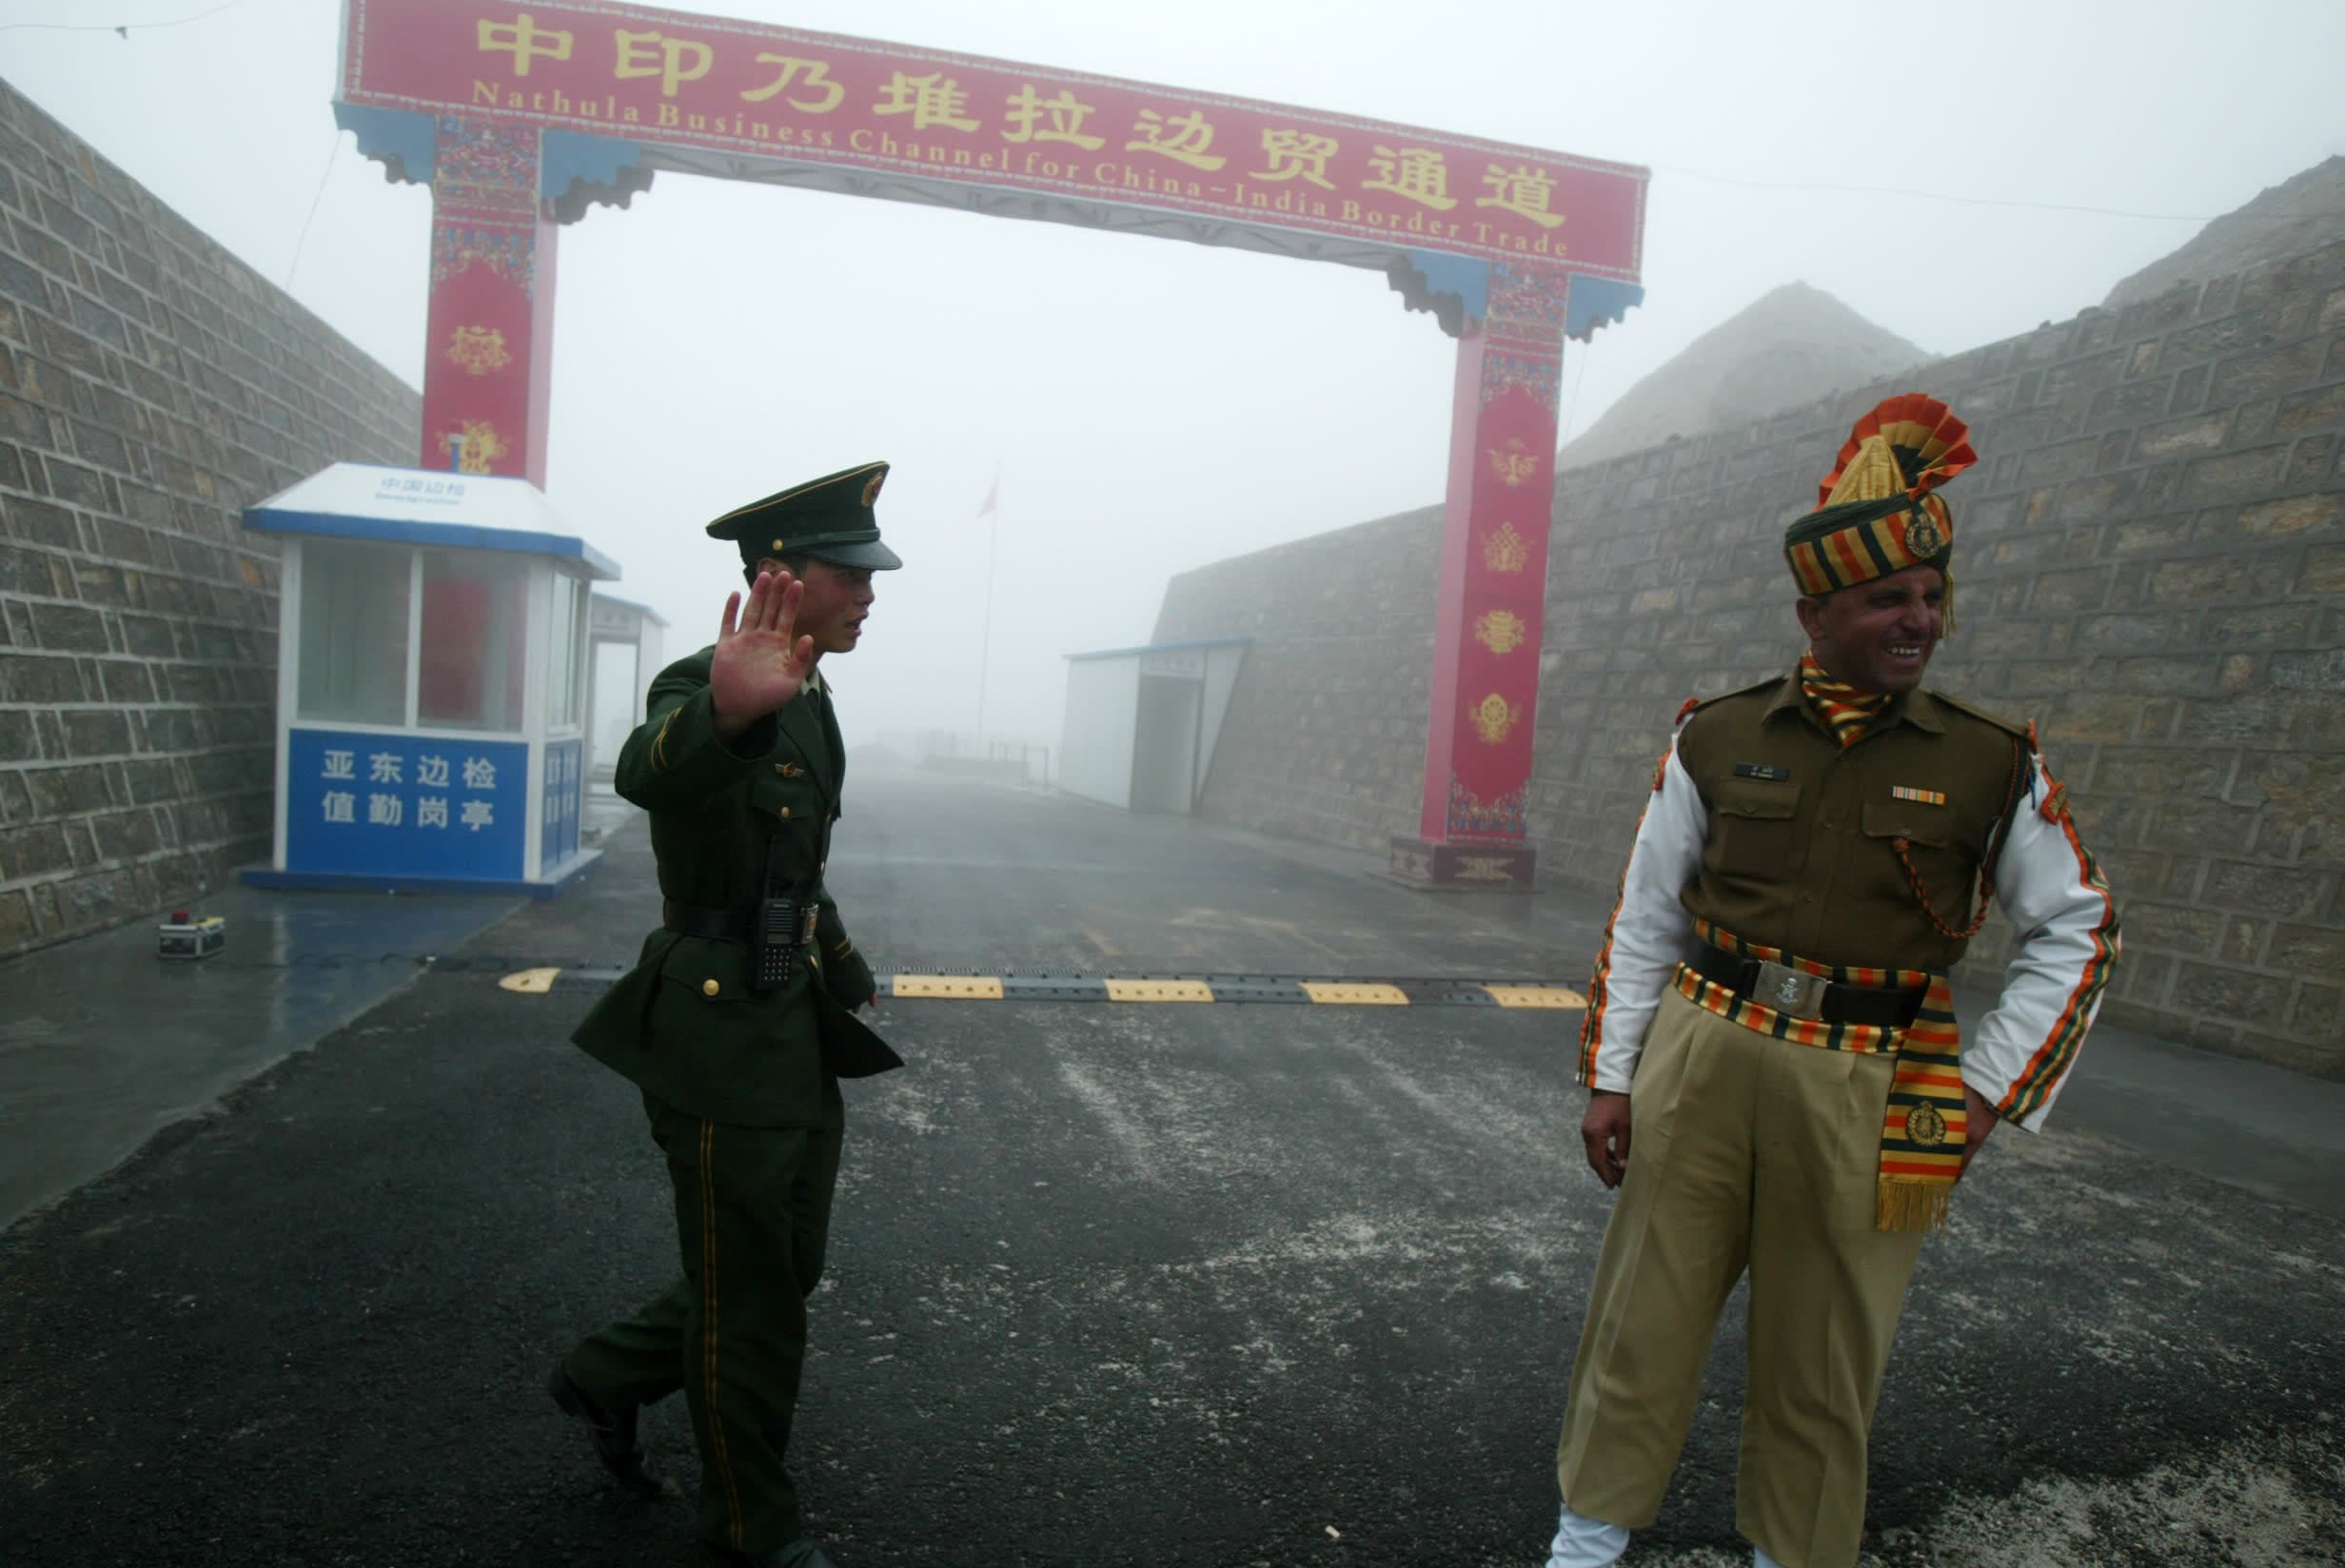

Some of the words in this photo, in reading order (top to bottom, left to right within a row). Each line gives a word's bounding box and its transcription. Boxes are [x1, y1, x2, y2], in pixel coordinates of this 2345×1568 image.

[472, 80, 640, 123] Nathula
[657, 103, 832, 146] Business
[850, 129, 1010, 169] Channel
[1025, 152, 1080, 181] for
[1342, 200, 1460, 237] Border
[1473, 223, 1568, 258] Trade
[476, 13, 1567, 229] 中印乃堆拉边贸通道
[322, 749, 496, 789] 亚东边检
[322, 791, 494, 832] 值勤岗亭
